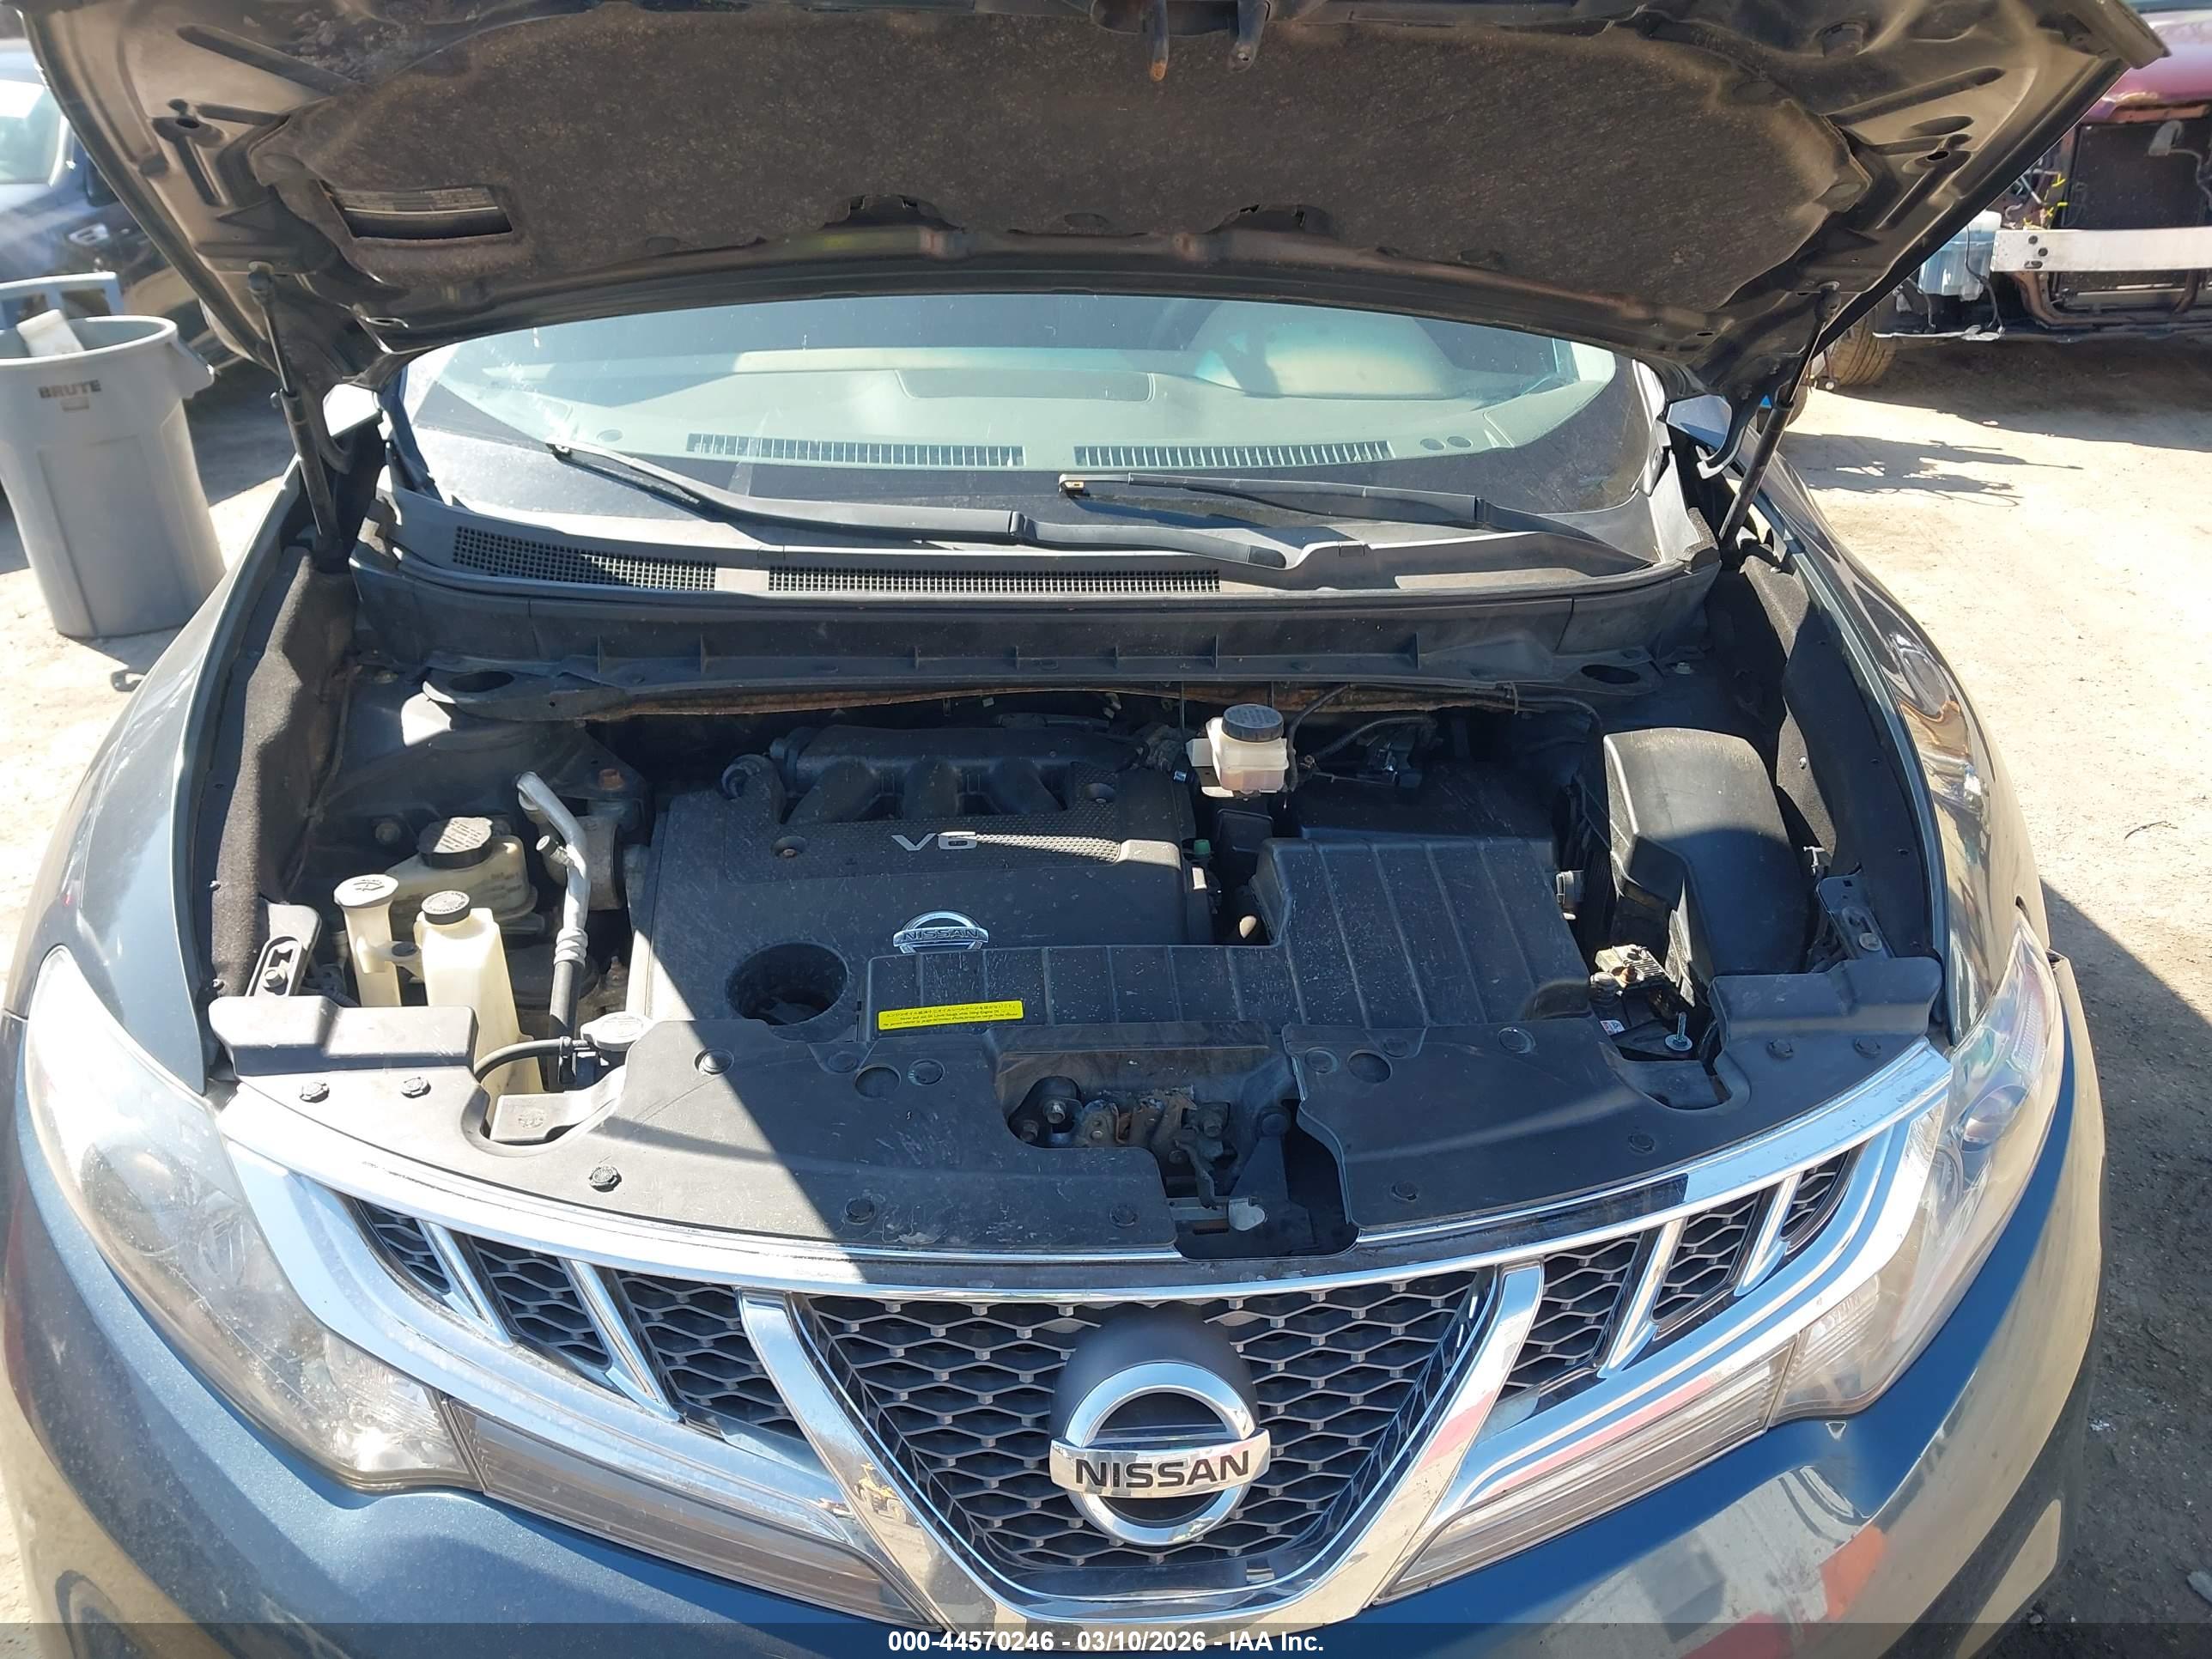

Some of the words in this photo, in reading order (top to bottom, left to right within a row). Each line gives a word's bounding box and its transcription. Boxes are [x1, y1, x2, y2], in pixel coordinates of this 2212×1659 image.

[39, 380, 101, 398] BRUTE
[891, 831, 977, 850] V6
[902, 928, 979, 941] NISSAN
[1075, 1449, 1249, 1488] NISSAN
